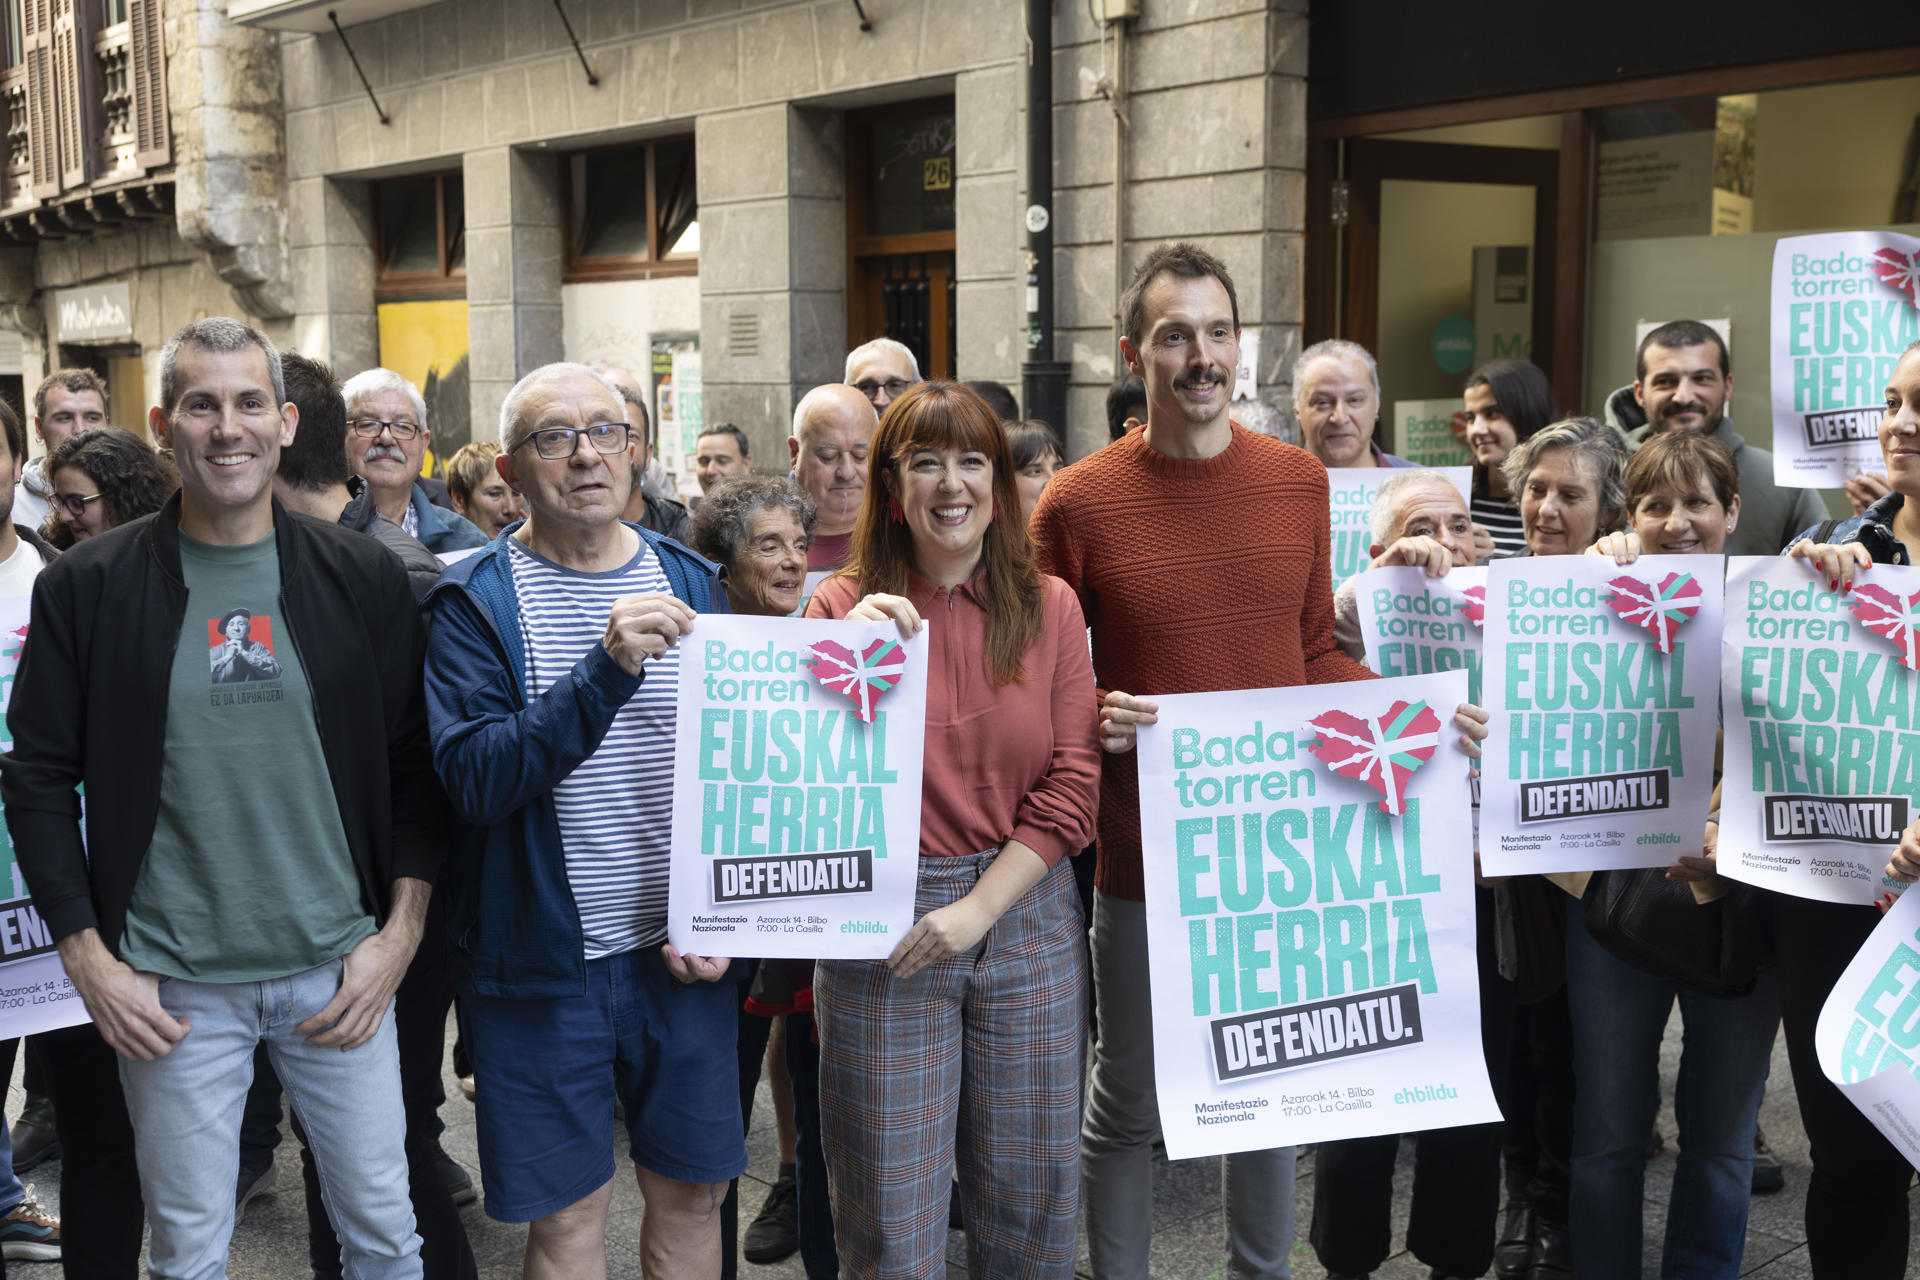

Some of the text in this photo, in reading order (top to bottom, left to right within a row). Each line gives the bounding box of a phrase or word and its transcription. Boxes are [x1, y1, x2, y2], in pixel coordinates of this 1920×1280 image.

[926, 161, 949, 186] 26
[1791, 277, 1874, 298] torren
[1790, 299, 1920, 356] EUSKA
[1794, 355, 1901, 412] HERR
[1811, 411, 1886, 443] DEFEND
[1373, 588, 1471, 617] Bada-
[1508, 579, 1616, 608] Bada-
[1747, 580, 1860, 613] Bada-
[1376, 616, 1466, 642] torren
[1507, 610, 1609, 635] torren
[1746, 612, 1850, 642] torren
[705, 640, 818, 673] Bada-
[704, 675, 809, 702] torren
[1505, 642, 1695, 710] EUSKAL
[1742, 646, 1920, 731] EUSKA
[699, 708, 898, 784] EUSKAL
[1172, 721, 1324, 769] Bada-
[1508, 711, 1684, 780] HERRIA
[1174, 768, 1316, 808] torren
[1528, 776, 1663, 818] DEFENDATU.
[701, 783, 888, 859] HERRIA
[1773, 800, 1900, 840] DEFENDATU.
[1501, 833, 1552, 843] Manifestazio
[1560, 832, 1592, 841] Azaroak
[1606, 831, 1625, 839] Bilbo
[1636, 833, 1681, 846] ehbildu
[1502, 843, 1541, 852] Nazionala
[1560, 841, 1580, 849] 17:00
[1595, 839, 1621, 848] Casilla
[1176, 798, 1441, 917] EUSKAL
[1741, 859, 1788, 873] Nazionala
[1810, 868, 1833, 877] 17:00
[1839, 868, 1850, 878] La
[1742, 852, 1801, 866] Manifestazio
[1810, 858, 1845, 869] Azaroak
[722, 858, 866, 898] DEFENDATU.
[692, 916, 888, 934] Manifestazio Azaroak 14 Bilbo ehbildu
[692, 924, 823, 933] Nazionala 17:00 La Casilla
[1188, 898, 1438, 1017] HERRIA
[44, 981, 55, 991] 14
[0, 997, 25, 1009] 7:00
[33, 995, 46, 1005] La
[1222, 995, 1413, 1072] DEFENDATU.
[1194, 1084, 1459, 1115] Manifestazio Azaroak 14 Bilbo ehbildu
[1197, 1099, 1372, 1126] Nazionala 17:00 La Casilla
